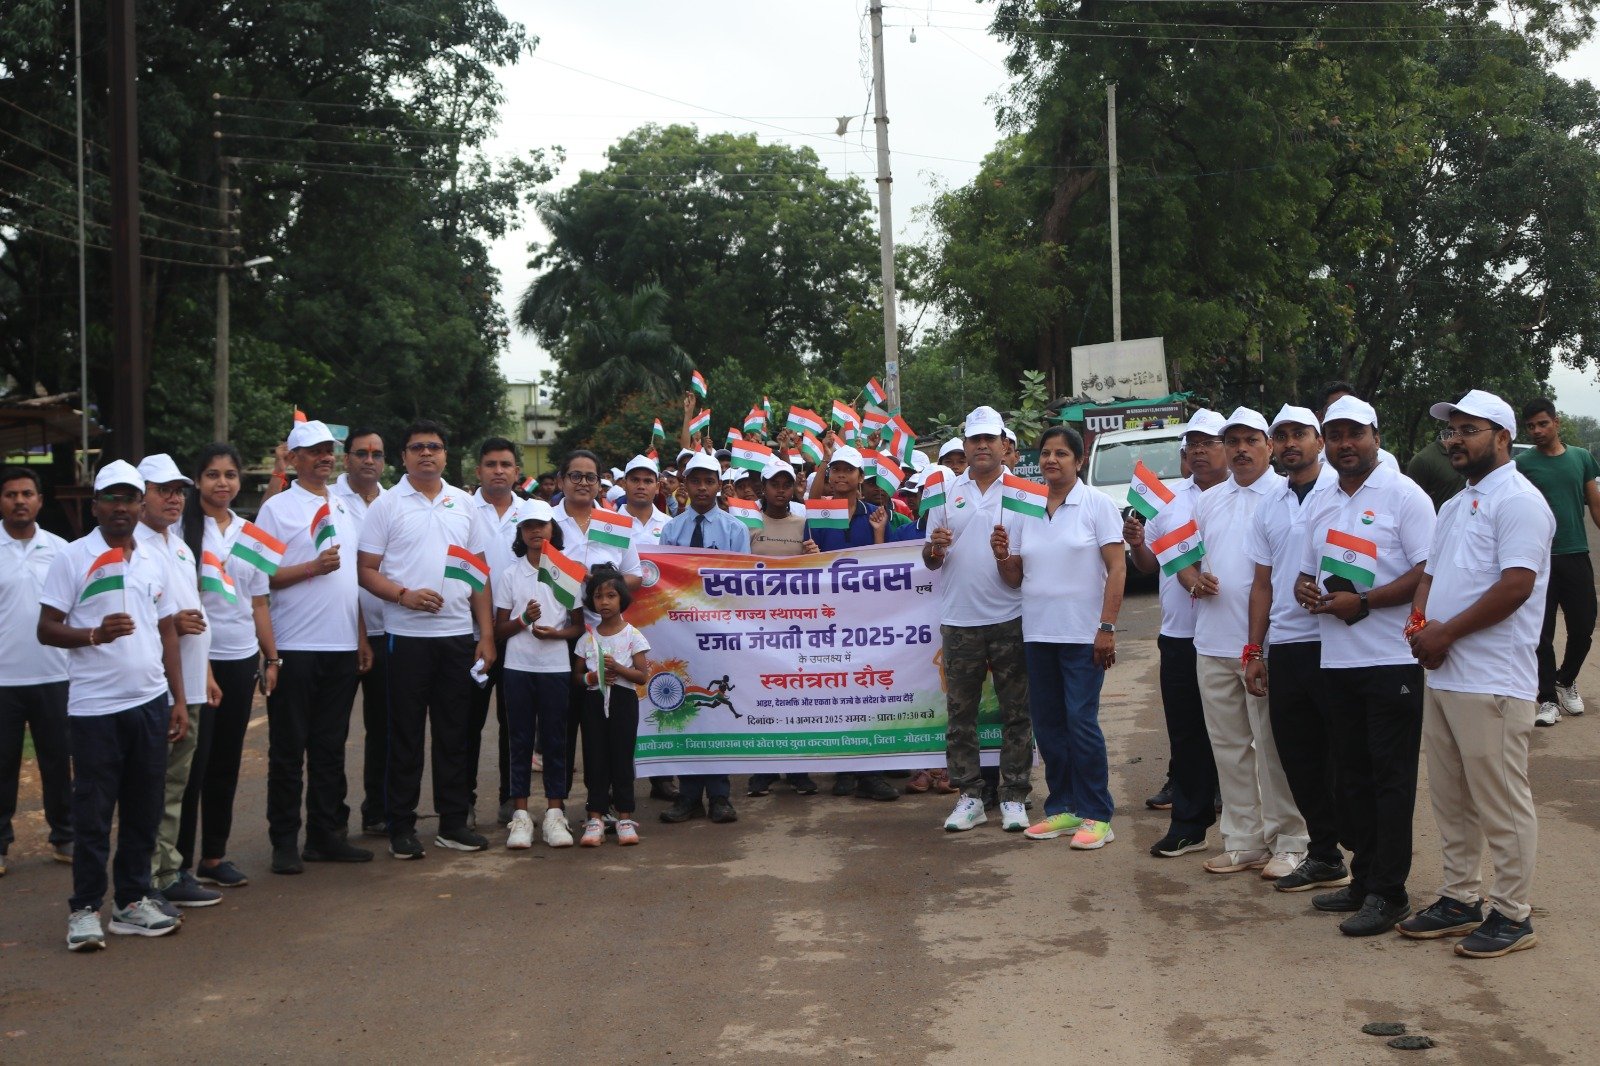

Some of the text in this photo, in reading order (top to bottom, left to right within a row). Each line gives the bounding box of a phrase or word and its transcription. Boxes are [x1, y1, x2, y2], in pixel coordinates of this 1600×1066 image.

[699, 562, 823, 596] स्वतंत्रता
[828, 558, 914, 593] दिवस
[915, 582, 933, 594] एवं
[667, 604, 836, 625] छत्तीसगढ़ राज्य स्थापना के
[696, 624, 932, 651] रजत जंयती वर्ष 2025-26
[798, 653, 807, 664] के
[810, 654, 842, 664] उपलक्ष्य
[760, 665, 894, 690] स्वतंत्रता दौड़
[775, 697, 800, 707] देशभक्ति
[801, 697, 813, 706] और
[814, 697, 830, 706] एकता
[832, 696, 839, 705] के
[854, 695, 861, 705] के
[862, 694, 879, 704] संदेश
[880, 694, 886, 703] के
[887, 694, 902, 703] साथ
[747, 714, 775, 725] दिनांक
[785, 716, 794, 725] 14
[796, 715, 823, 725] अगस्त
[824, 714, 843, 724] 2025
[845, 713, 867, 723] समय
[897, 711, 919, 720] 07:30
[920, 708, 935, 720] बजे
[685, 738, 707, 749] जिला
[708, 739, 741, 749] प्रशासन
[742, 737, 755, 749] एवं
[756, 737, 774, 748] खेल
[776, 736, 789, 748] एवं
[790, 738, 806, 750] युवा
[807, 737, 840, 747] कल्याण
[841, 735, 872, 747] विभाग,
[873, 733, 896, 745] जिला
